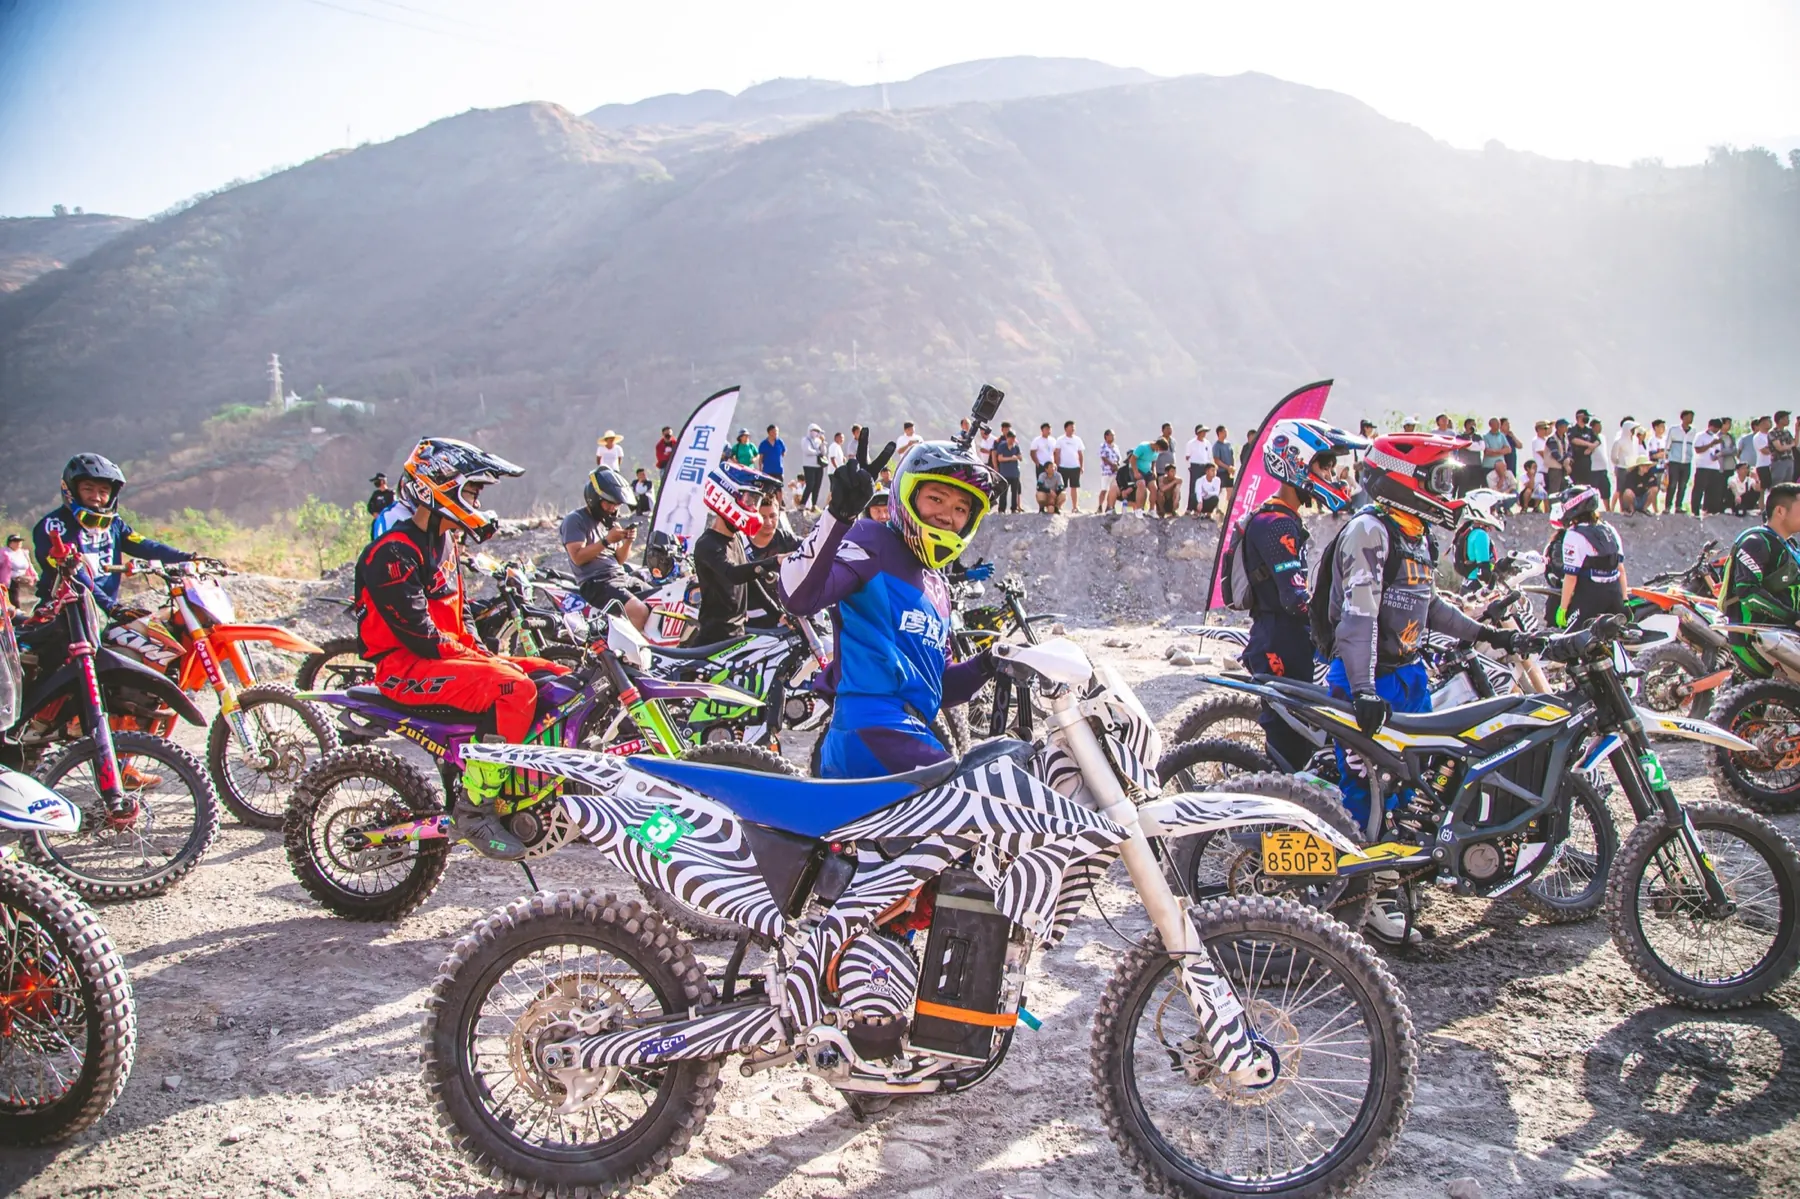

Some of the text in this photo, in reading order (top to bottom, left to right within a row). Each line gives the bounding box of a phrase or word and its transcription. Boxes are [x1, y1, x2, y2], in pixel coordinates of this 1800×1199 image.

[107, 626, 184, 667] KTM
[27, 798, 61, 814] KTM
[647, 816, 677, 844] 3
[1267, 852, 1332, 872] 850P3
